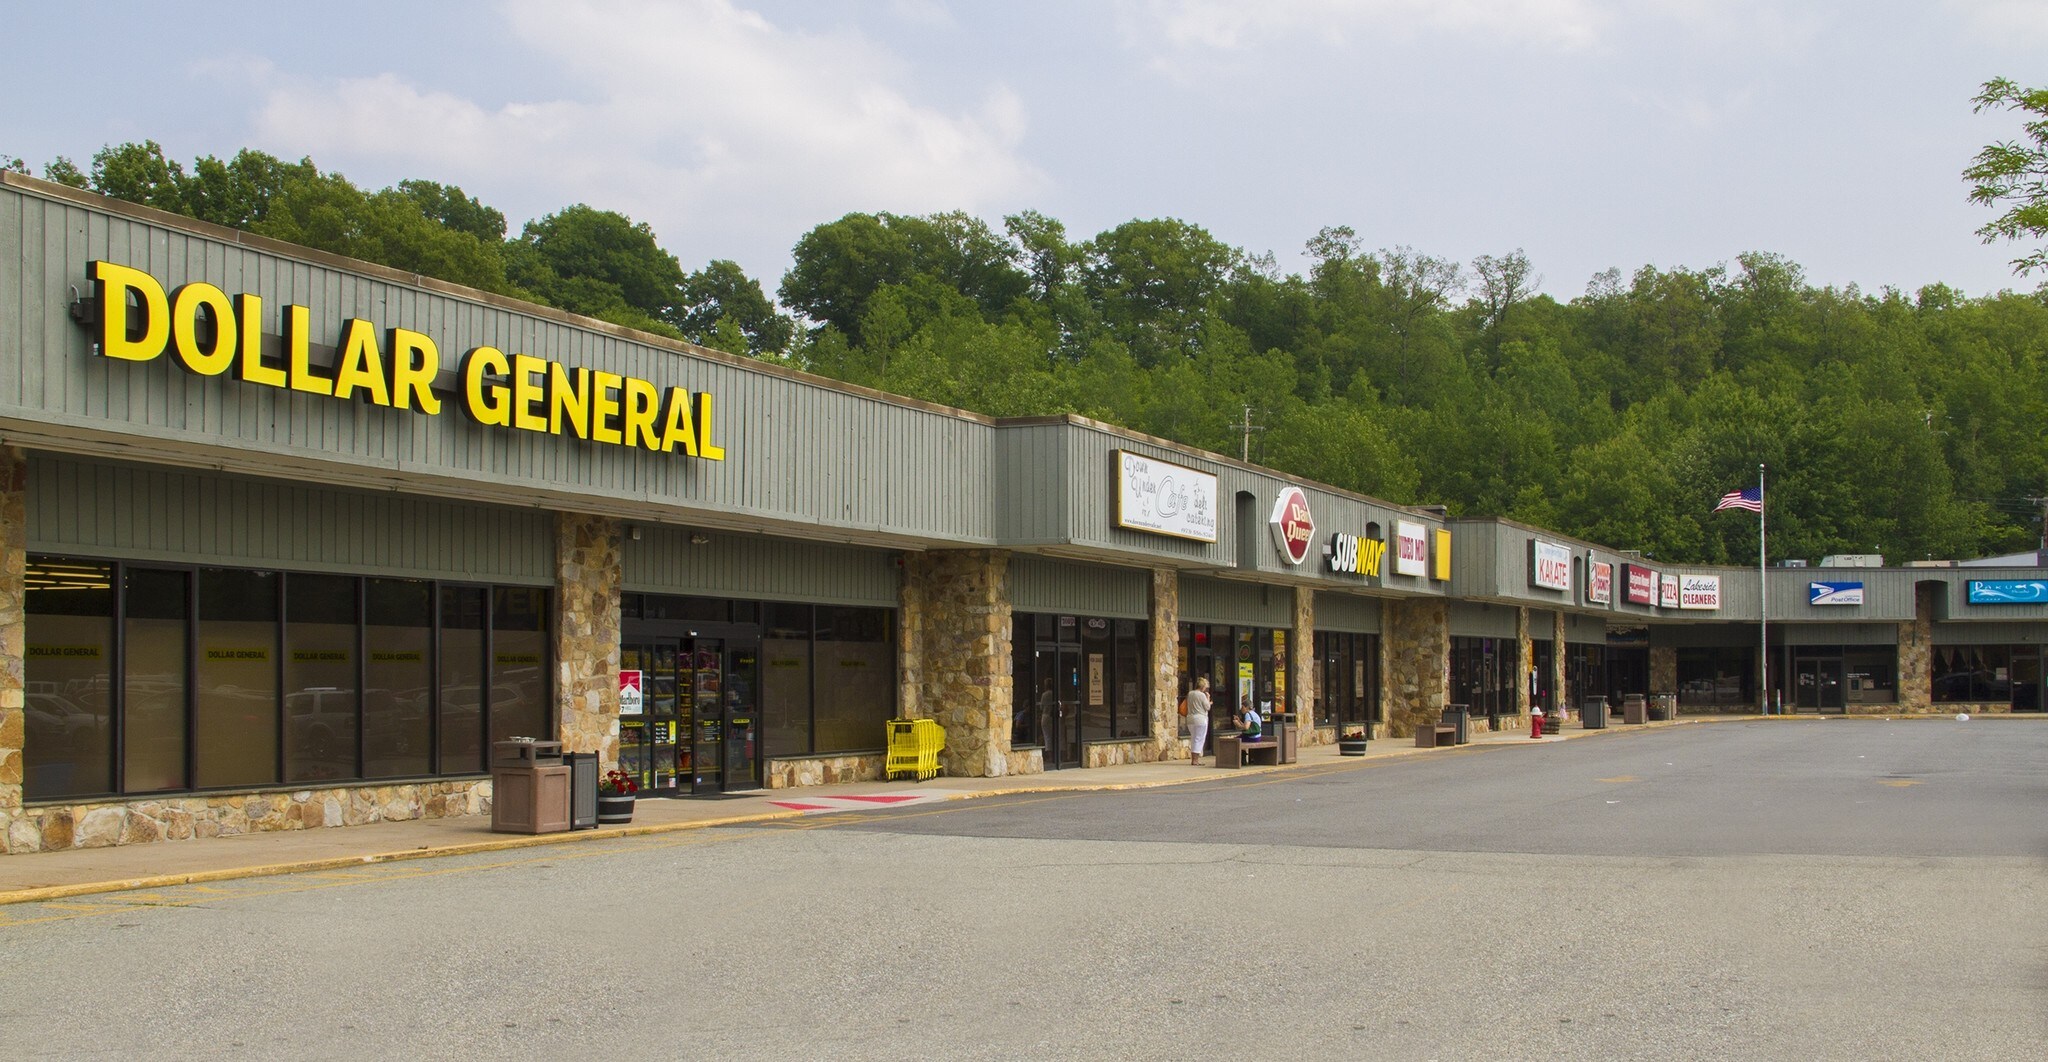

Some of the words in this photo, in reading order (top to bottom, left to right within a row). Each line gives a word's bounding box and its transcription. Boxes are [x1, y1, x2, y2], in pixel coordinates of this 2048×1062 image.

[92, 260, 441, 415] DOLLAR
[463, 346, 725, 461] GENERAL
[1124, 456, 1148, 478] Down
[1131, 475, 1157, 498] Under
[1331, 532, 1386, 577] SUBWAY
[1539, 558, 1567, 586] KARATE
[1661, 583, 1678, 600] PIZZA
[1683, 579, 1717, 592] Lakeside
[1683, 593, 1717, 605] CLEANERS
[29, 647, 62, 657] DOLLAR
[63, 647, 99, 657] GENERAL
[208, 650, 235, 659] DOLLAR
[236, 650, 266, 660] GENERAL
[294, 652, 318, 661] DOLLAR
[319, 652, 346, 662] GENERAL
[372, 652, 395, 662] DOLLAR
[396, 653, 420, 662] GENERAL
